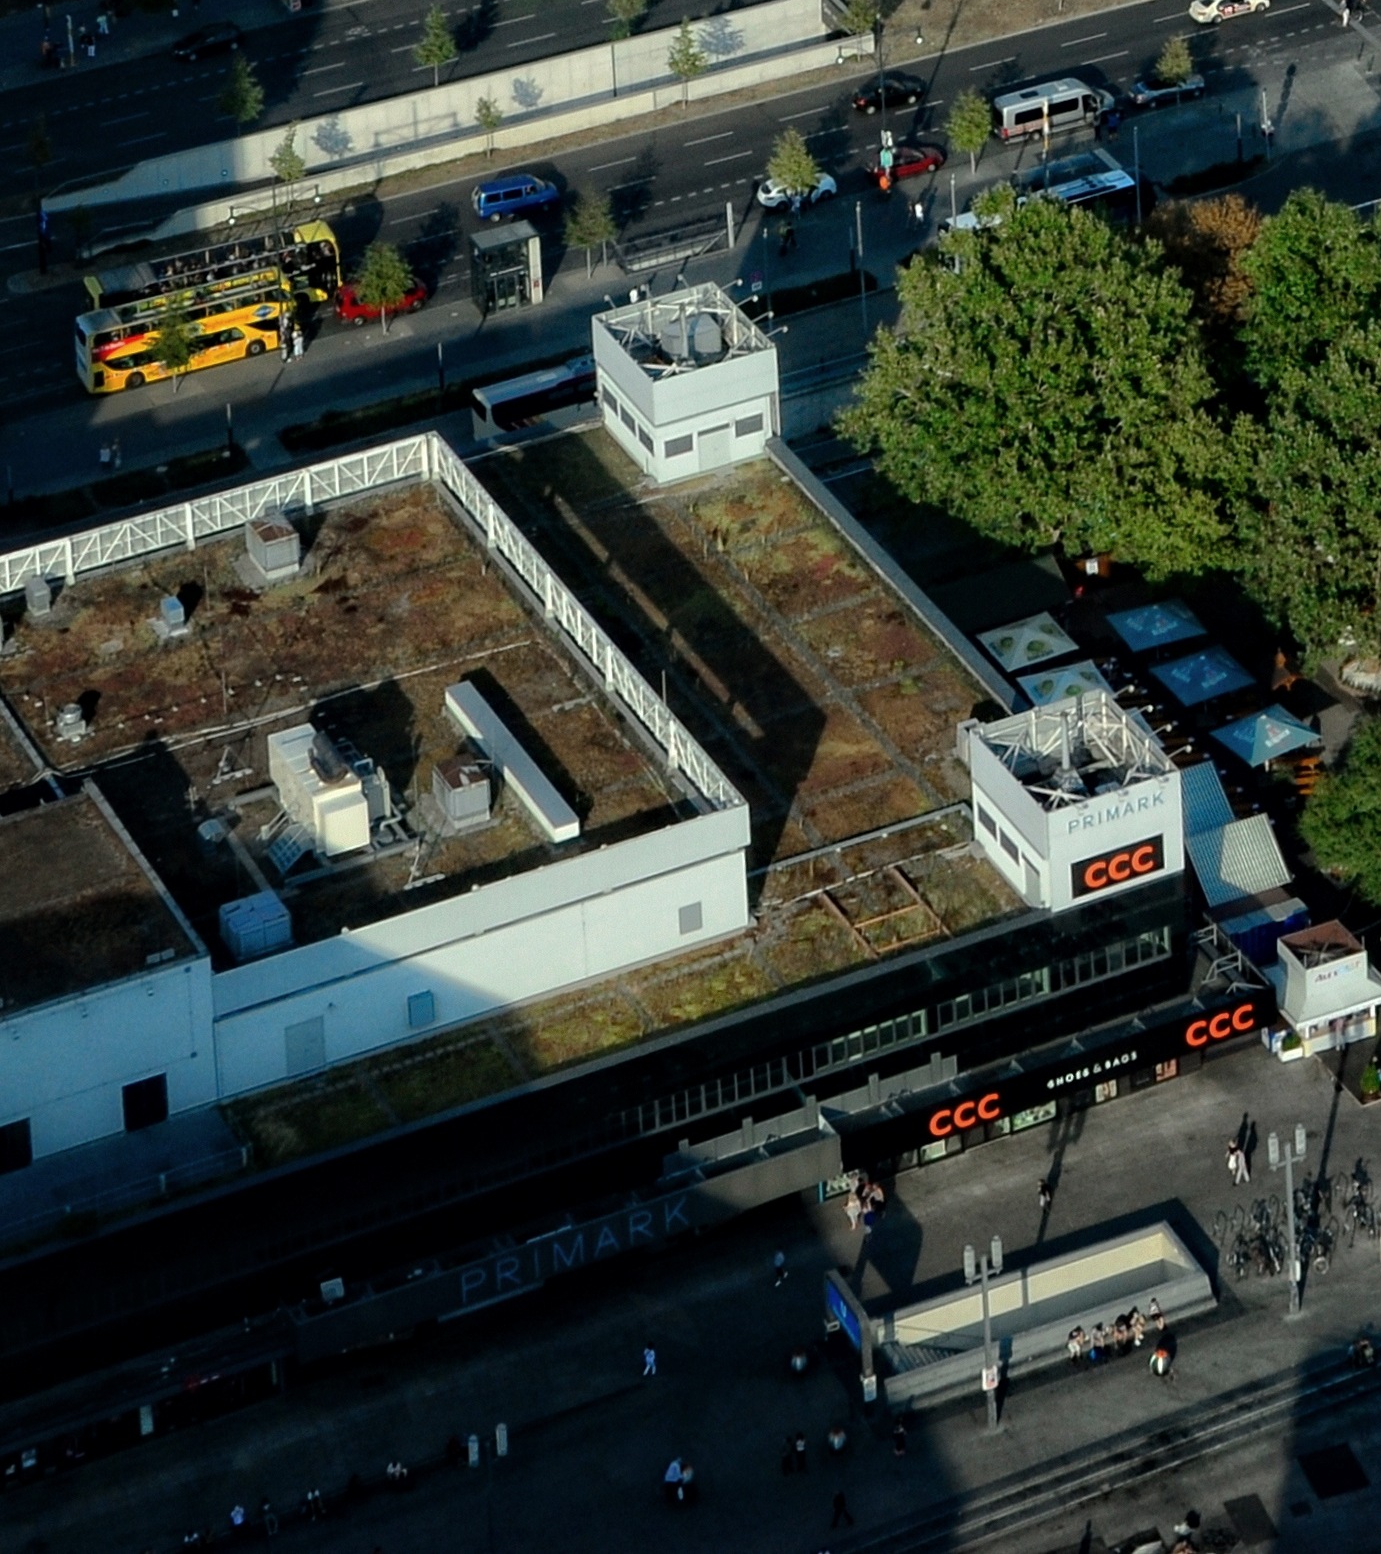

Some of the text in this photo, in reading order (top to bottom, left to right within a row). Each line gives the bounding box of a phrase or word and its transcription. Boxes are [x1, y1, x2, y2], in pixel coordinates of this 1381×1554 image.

[1067, 791, 1165, 834] PRIMARK
[1084, 846, 1154, 888] CCC
[1186, 1004, 1254, 1047] CCC
[1047, 1067, 1089, 1089] SHOES
[1104, 1051, 1138, 1069] BAGS
[929, 1093, 1000, 1136] CCC
[461, 1197, 689, 1304] PRIMARK
